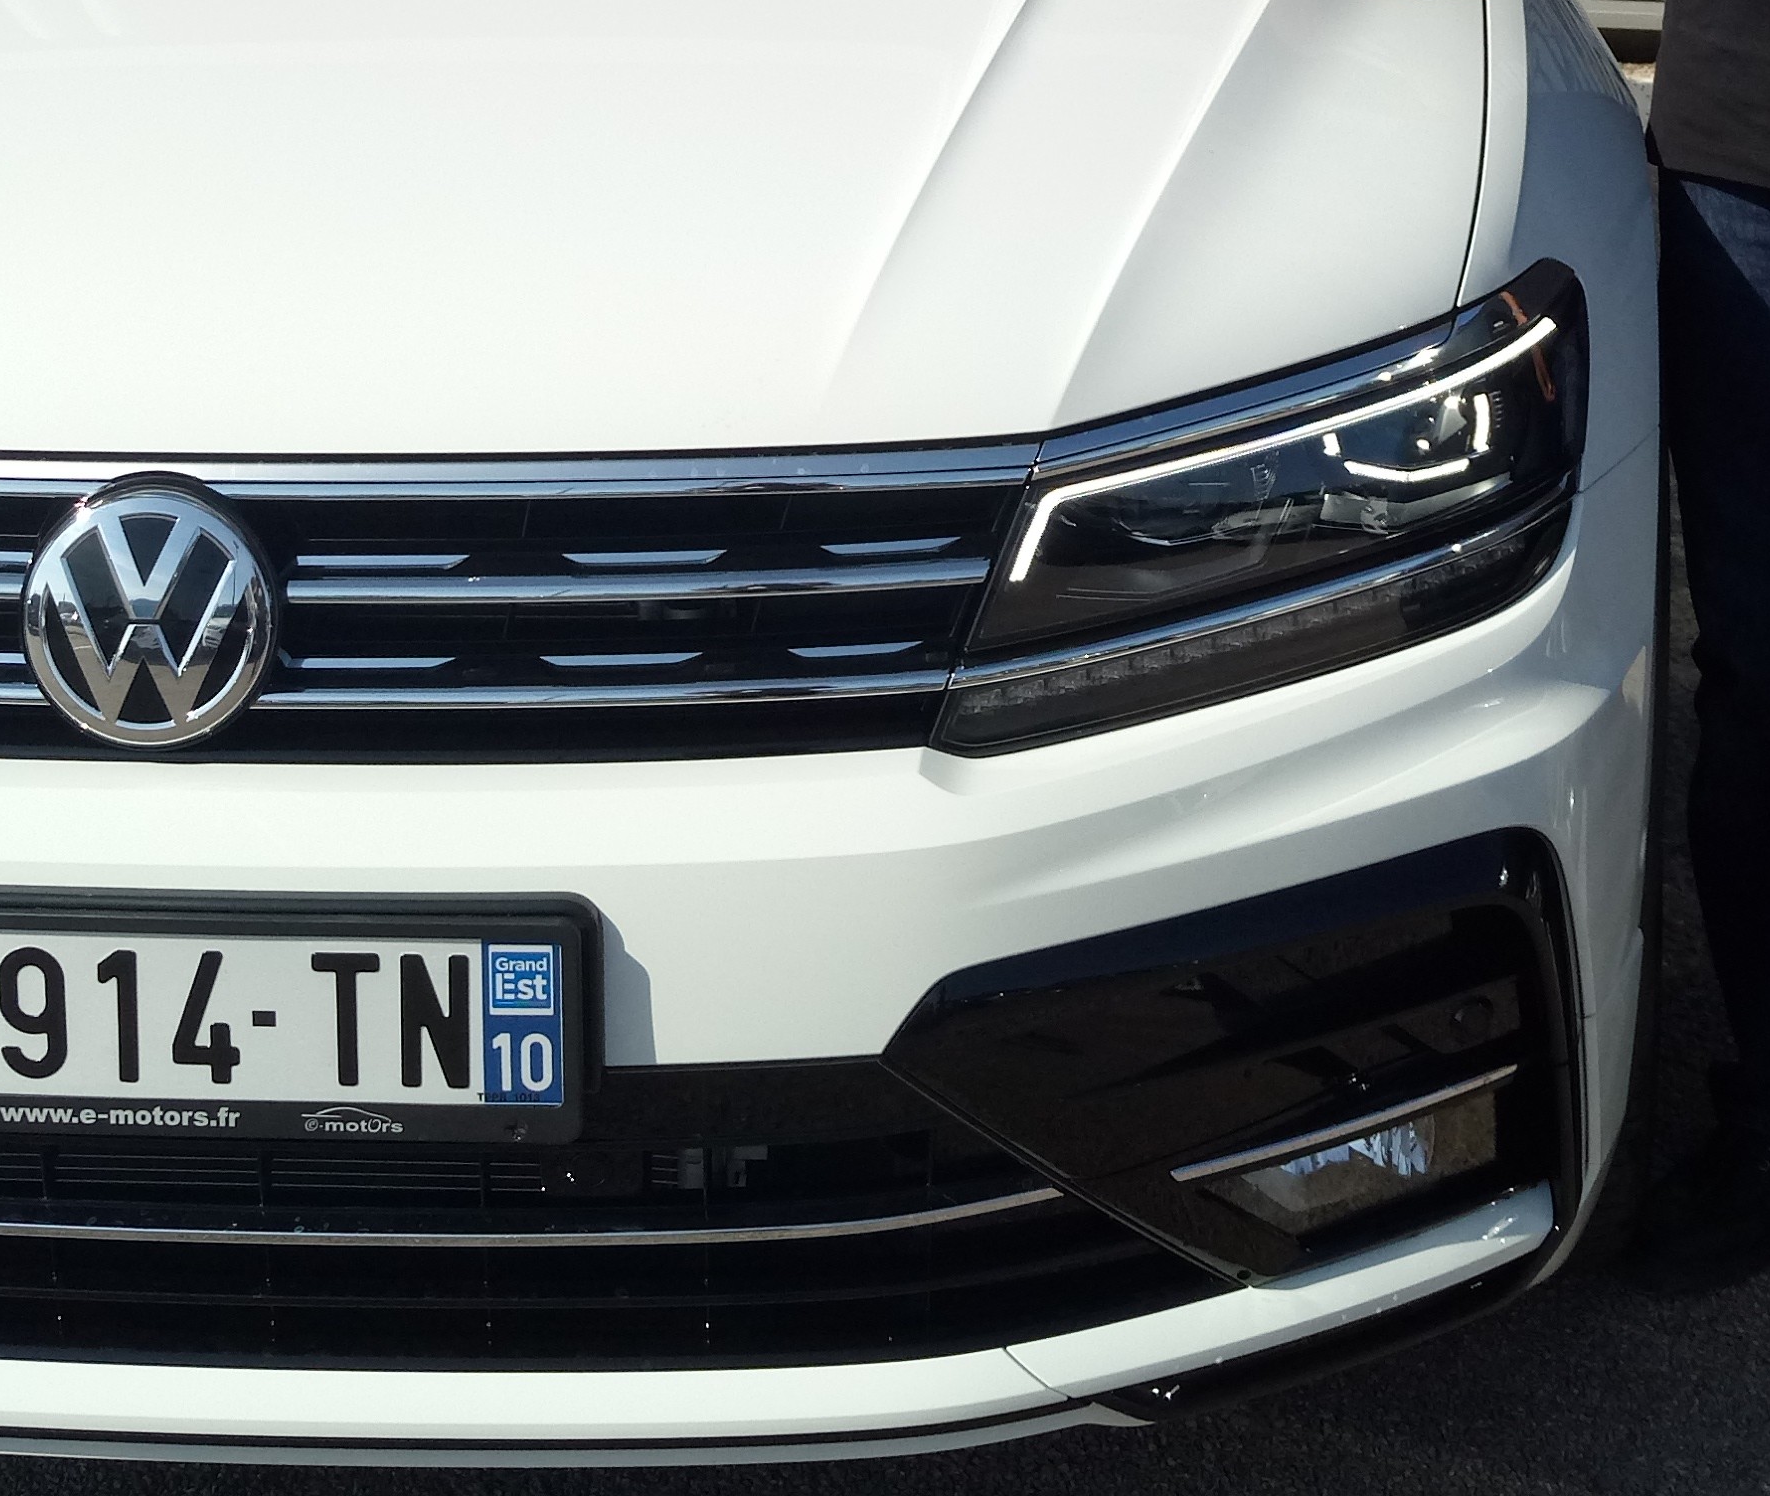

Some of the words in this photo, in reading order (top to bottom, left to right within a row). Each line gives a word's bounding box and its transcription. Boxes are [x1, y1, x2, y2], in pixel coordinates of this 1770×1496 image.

[495, 957, 548, 972] Grand
[495, 973, 548, 1000] Est
[492, 1032, 553, 1092] 10
[0, 1106, 241, 1128] www.e-motors.fr
